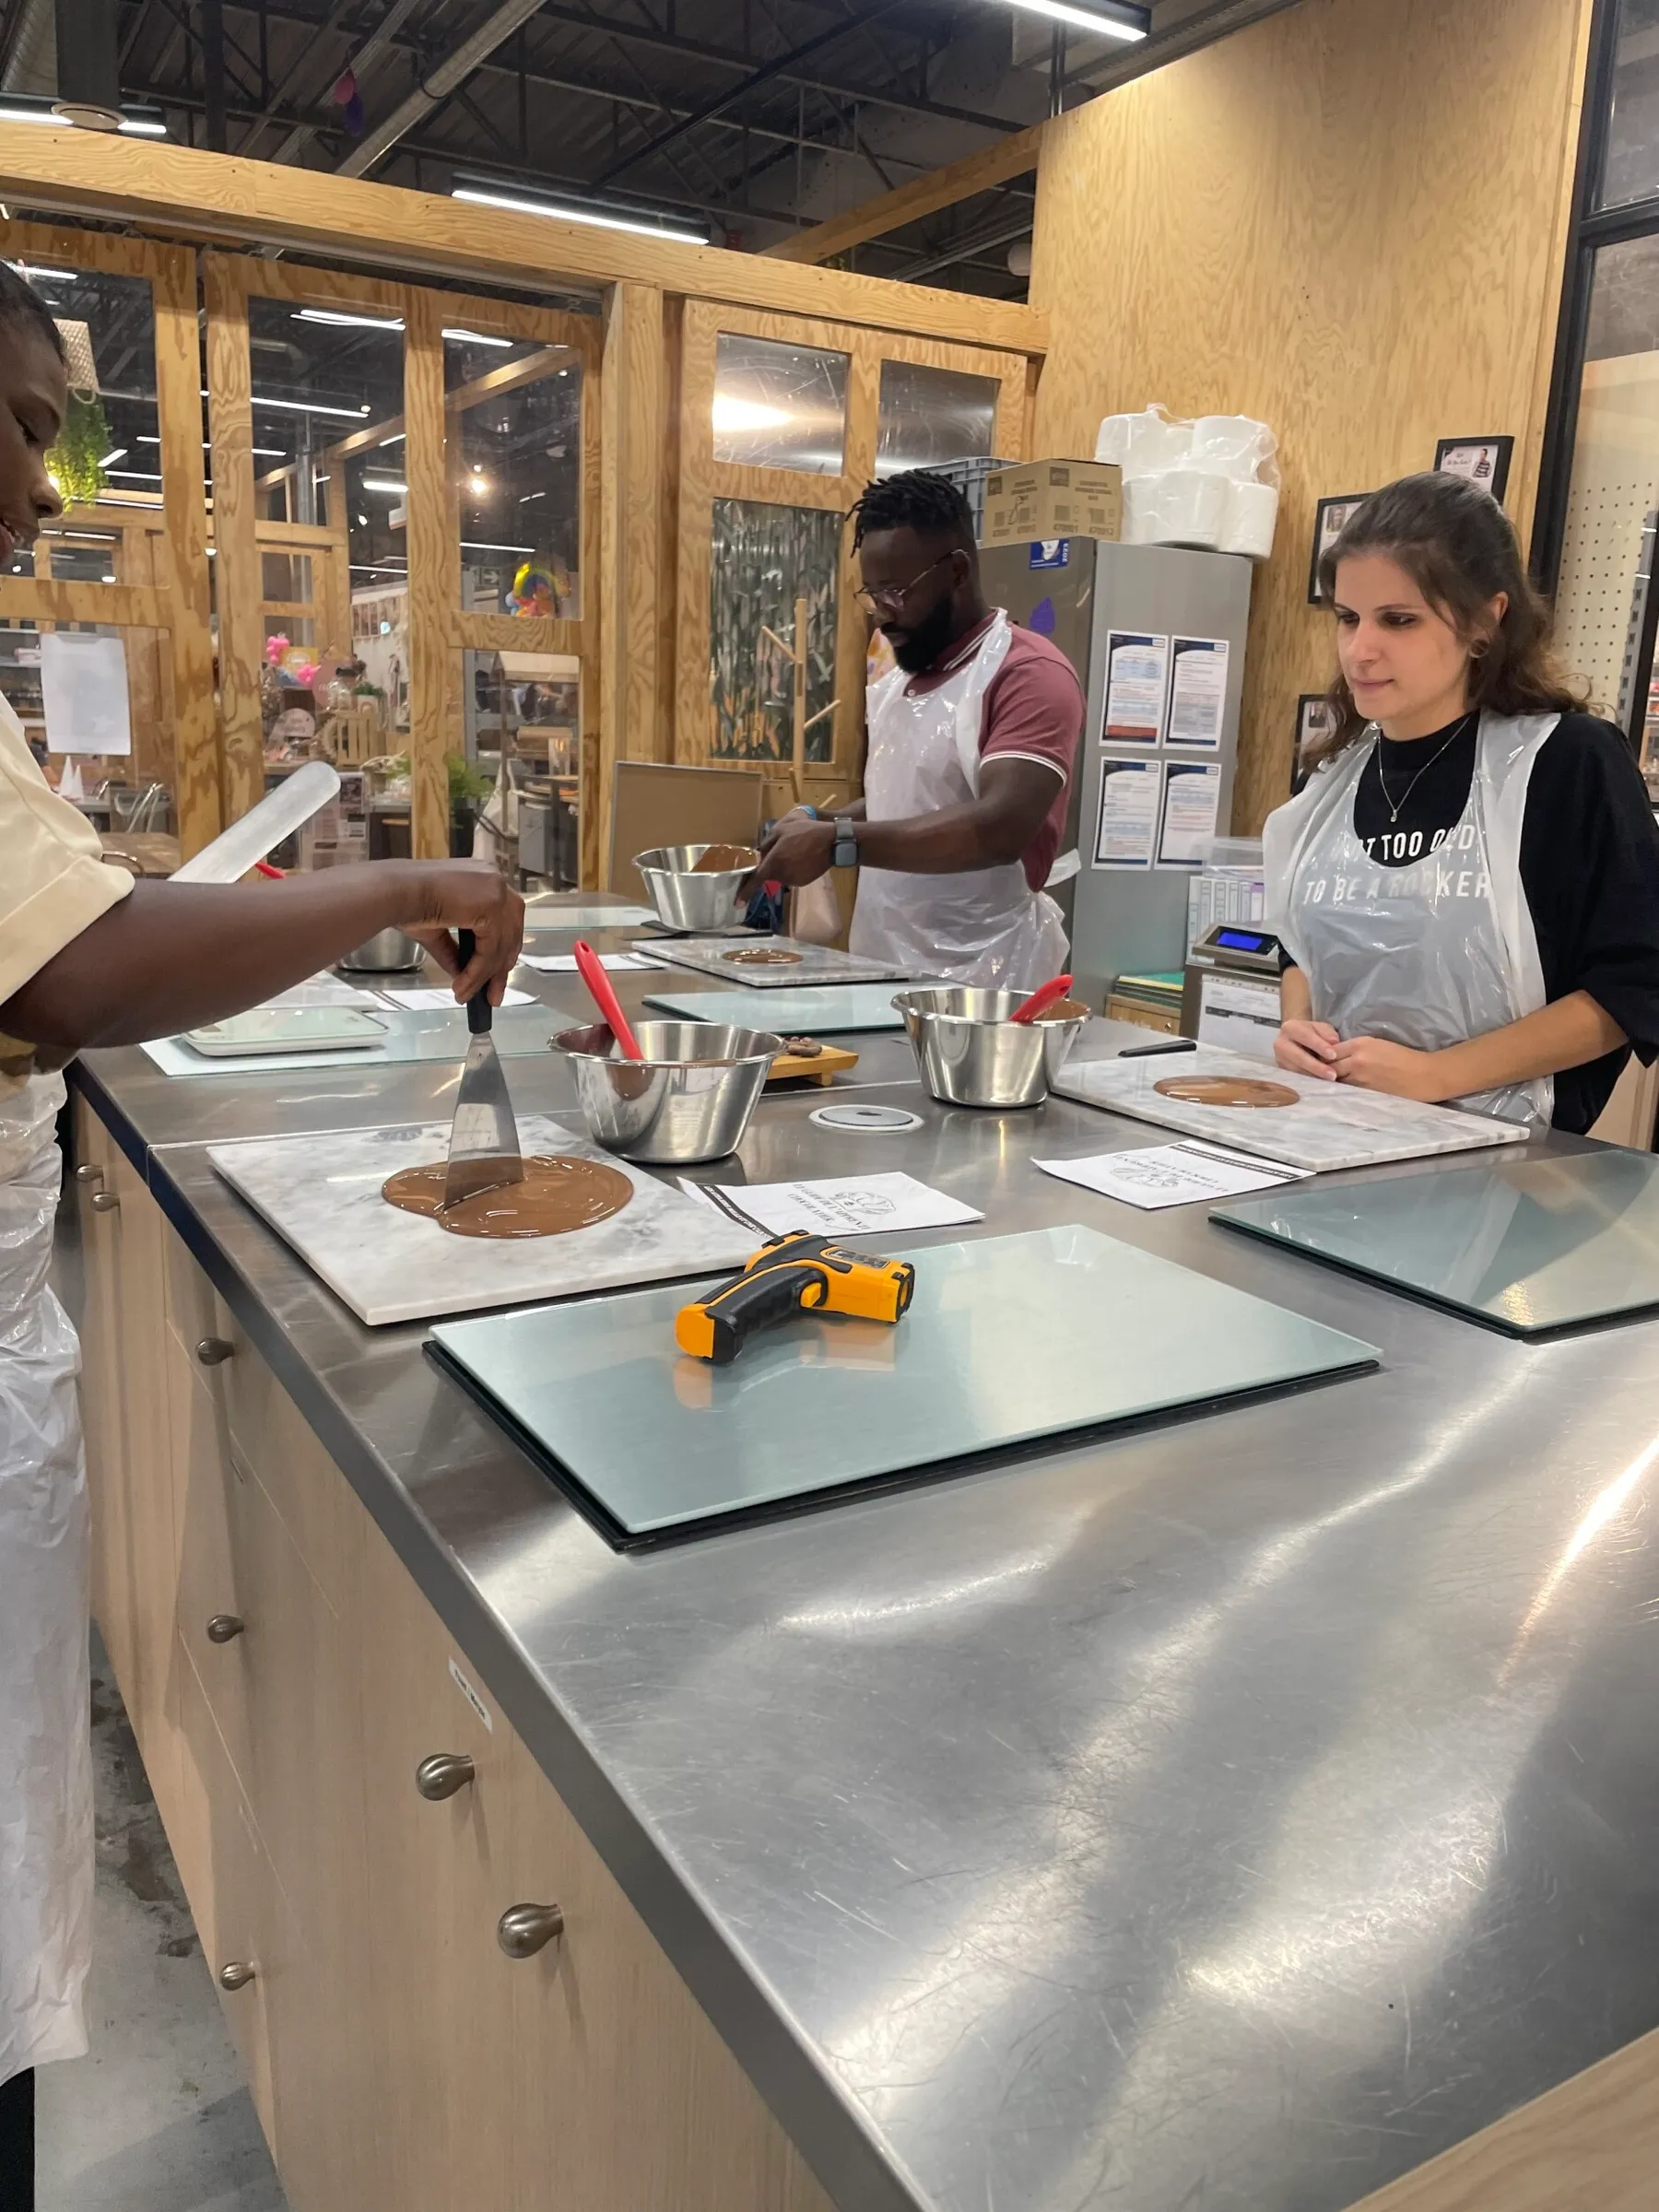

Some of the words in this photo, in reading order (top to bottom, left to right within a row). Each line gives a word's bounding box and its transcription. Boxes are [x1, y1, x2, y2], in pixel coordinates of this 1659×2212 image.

[1382, 831, 1423, 860] TOO
[1303, 879, 1326, 904] TO
[1333, 875, 1362, 901] BE
[1366, 877, 1382, 899] A
